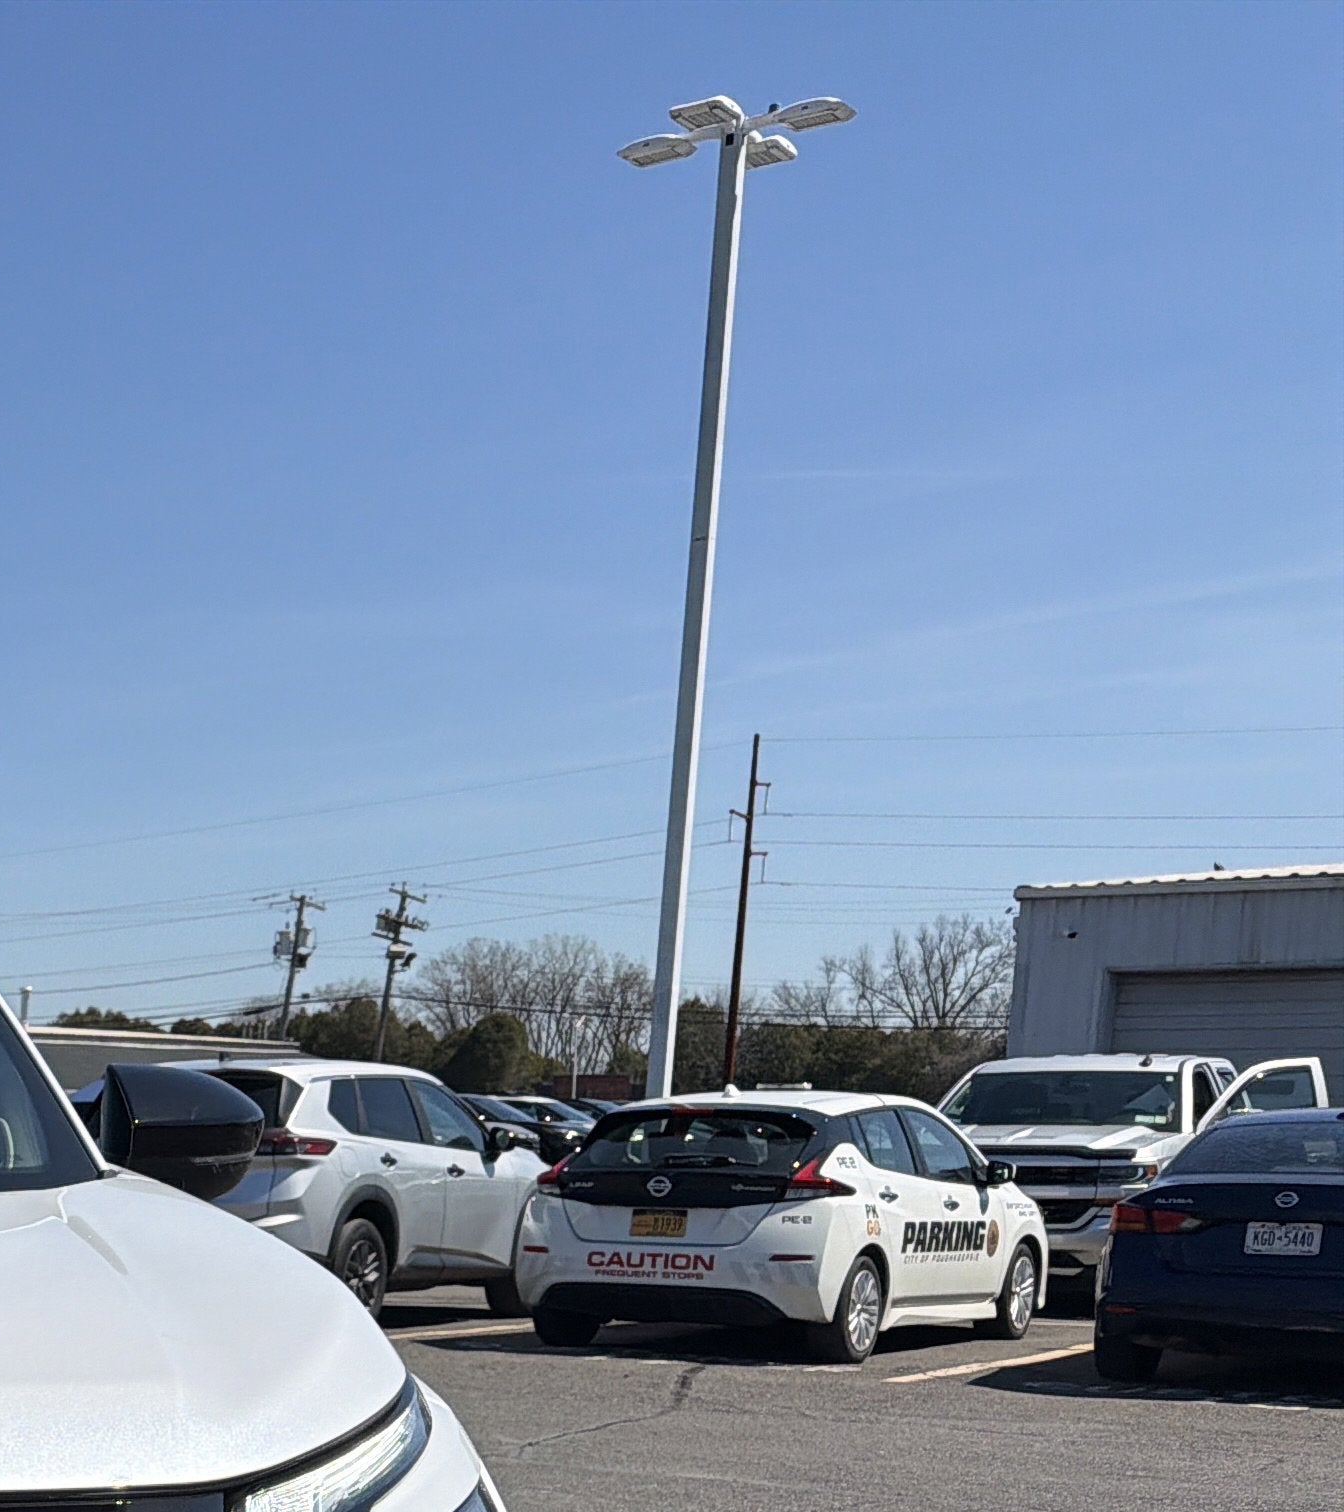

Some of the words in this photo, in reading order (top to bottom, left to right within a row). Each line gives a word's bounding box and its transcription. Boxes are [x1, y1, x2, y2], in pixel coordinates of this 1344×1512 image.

[900, 1220, 988, 1254] PARKING
[586, 1250, 715, 1271] CAUTION
[594, 1268, 658, 1279] FREQUENT
[661, 1271, 704, 1280] STOPS
